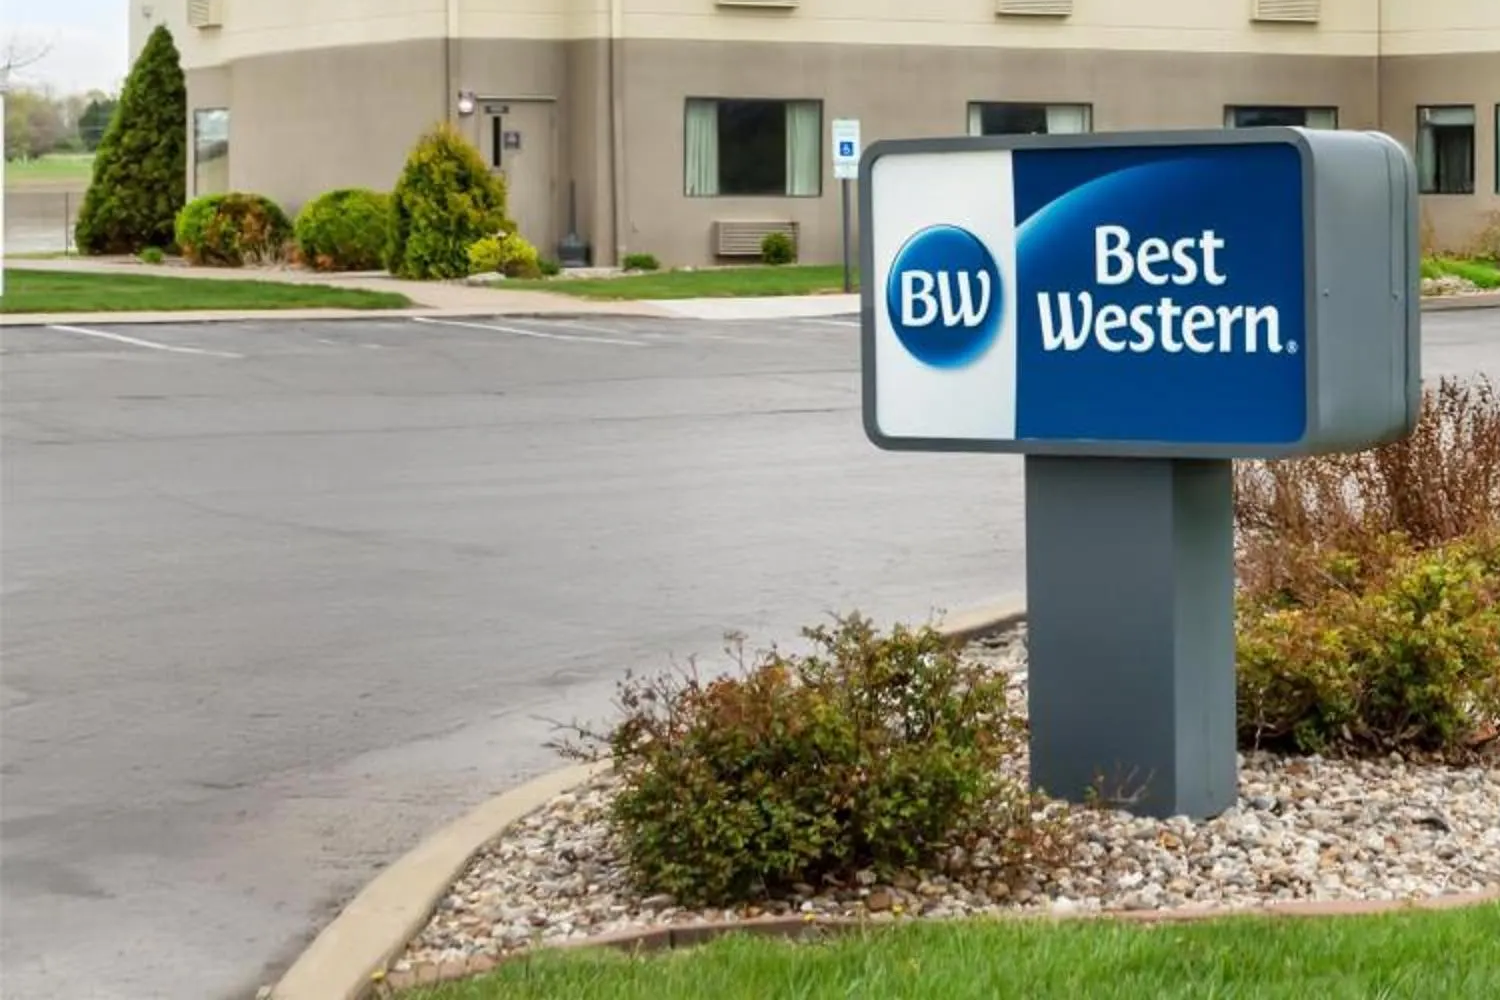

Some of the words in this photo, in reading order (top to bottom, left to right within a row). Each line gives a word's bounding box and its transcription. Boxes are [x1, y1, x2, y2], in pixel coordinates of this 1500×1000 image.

[1095, 225, 1227, 286] Best
[901, 269, 991, 327] BW
[1037, 291, 1284, 353] Western
